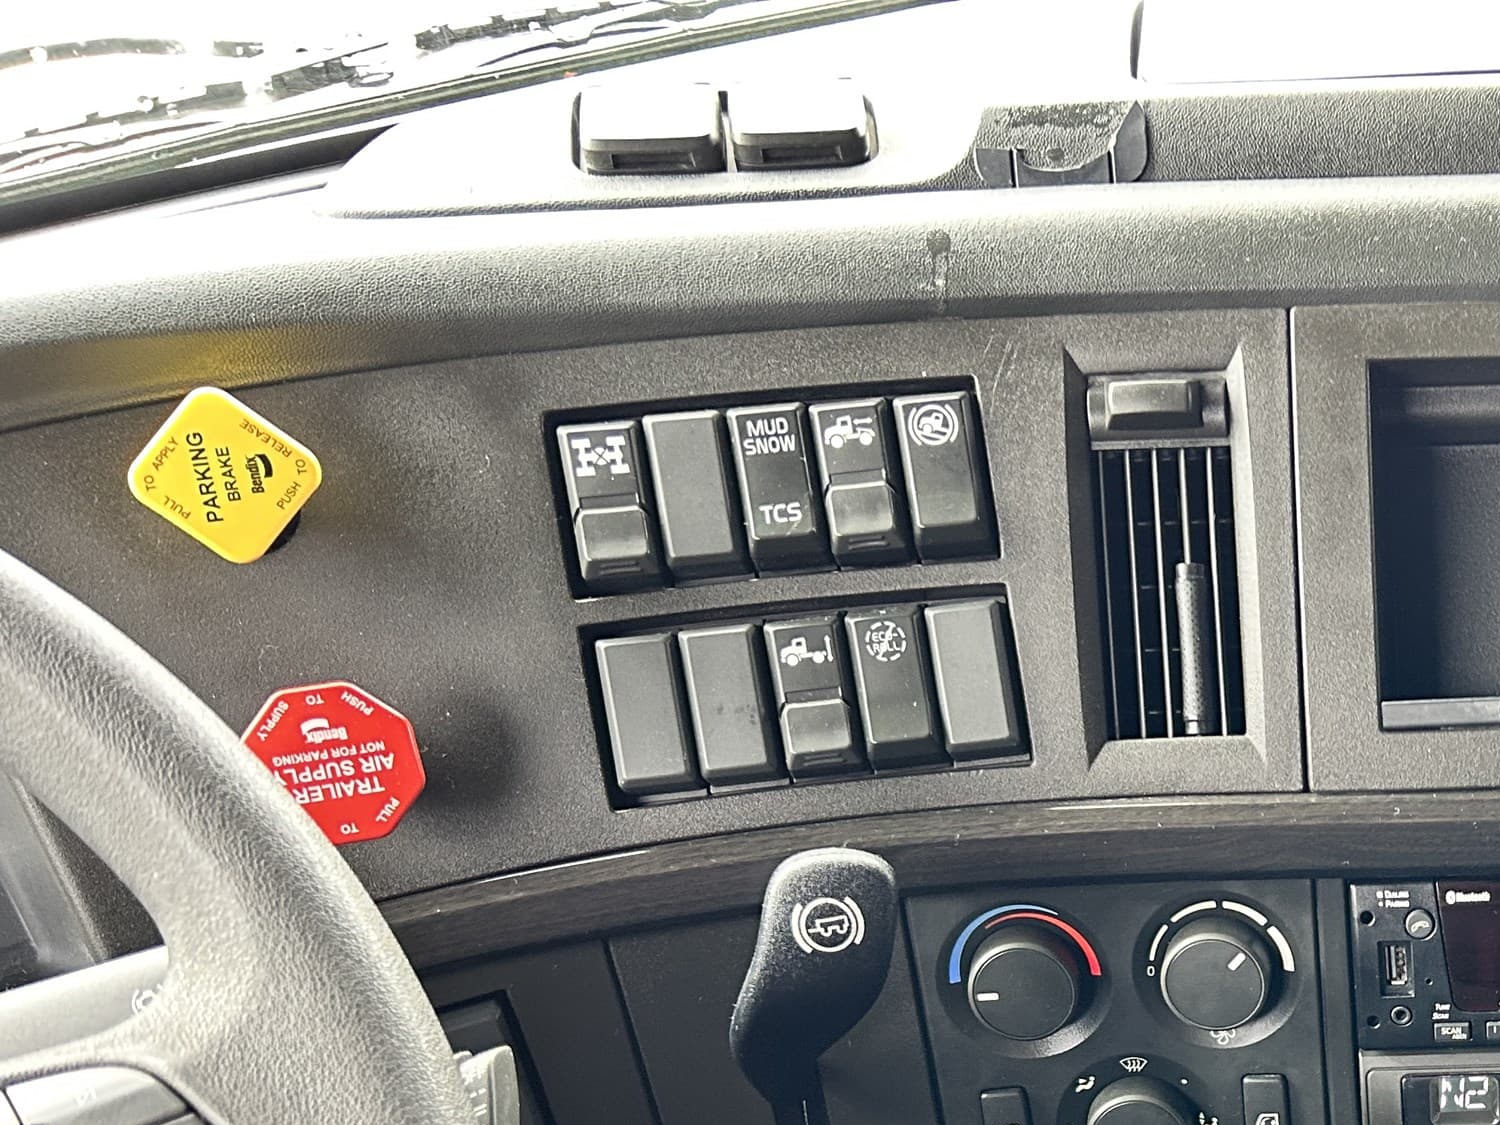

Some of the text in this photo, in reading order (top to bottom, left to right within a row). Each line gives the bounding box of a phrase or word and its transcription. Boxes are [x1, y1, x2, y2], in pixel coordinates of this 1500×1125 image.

[746, 417, 789, 436] MUD
[743, 433, 796, 456] SNOW
[143, 436, 191, 520] PULL TO APPLY
[186, 432, 224, 523] PARKING
[215, 446, 241, 501] BRAKE
[239, 418, 307, 510] PUSH TO RELEASE
[246, 455, 265, 494] Bendix
[759, 503, 803, 524] TCS
[256, 691, 374, 742] PUSH TO SUPPLY
[304, 727, 348, 744] Bendix
[272, 740, 385, 767] NOT FOR PARKING
[272, 752, 394, 787] AIR SUPPLY
[293, 776, 386, 804] TRAILER
[340, 796, 400, 835] PULL TO
[1440, 1076, 1489, 1109] N2
